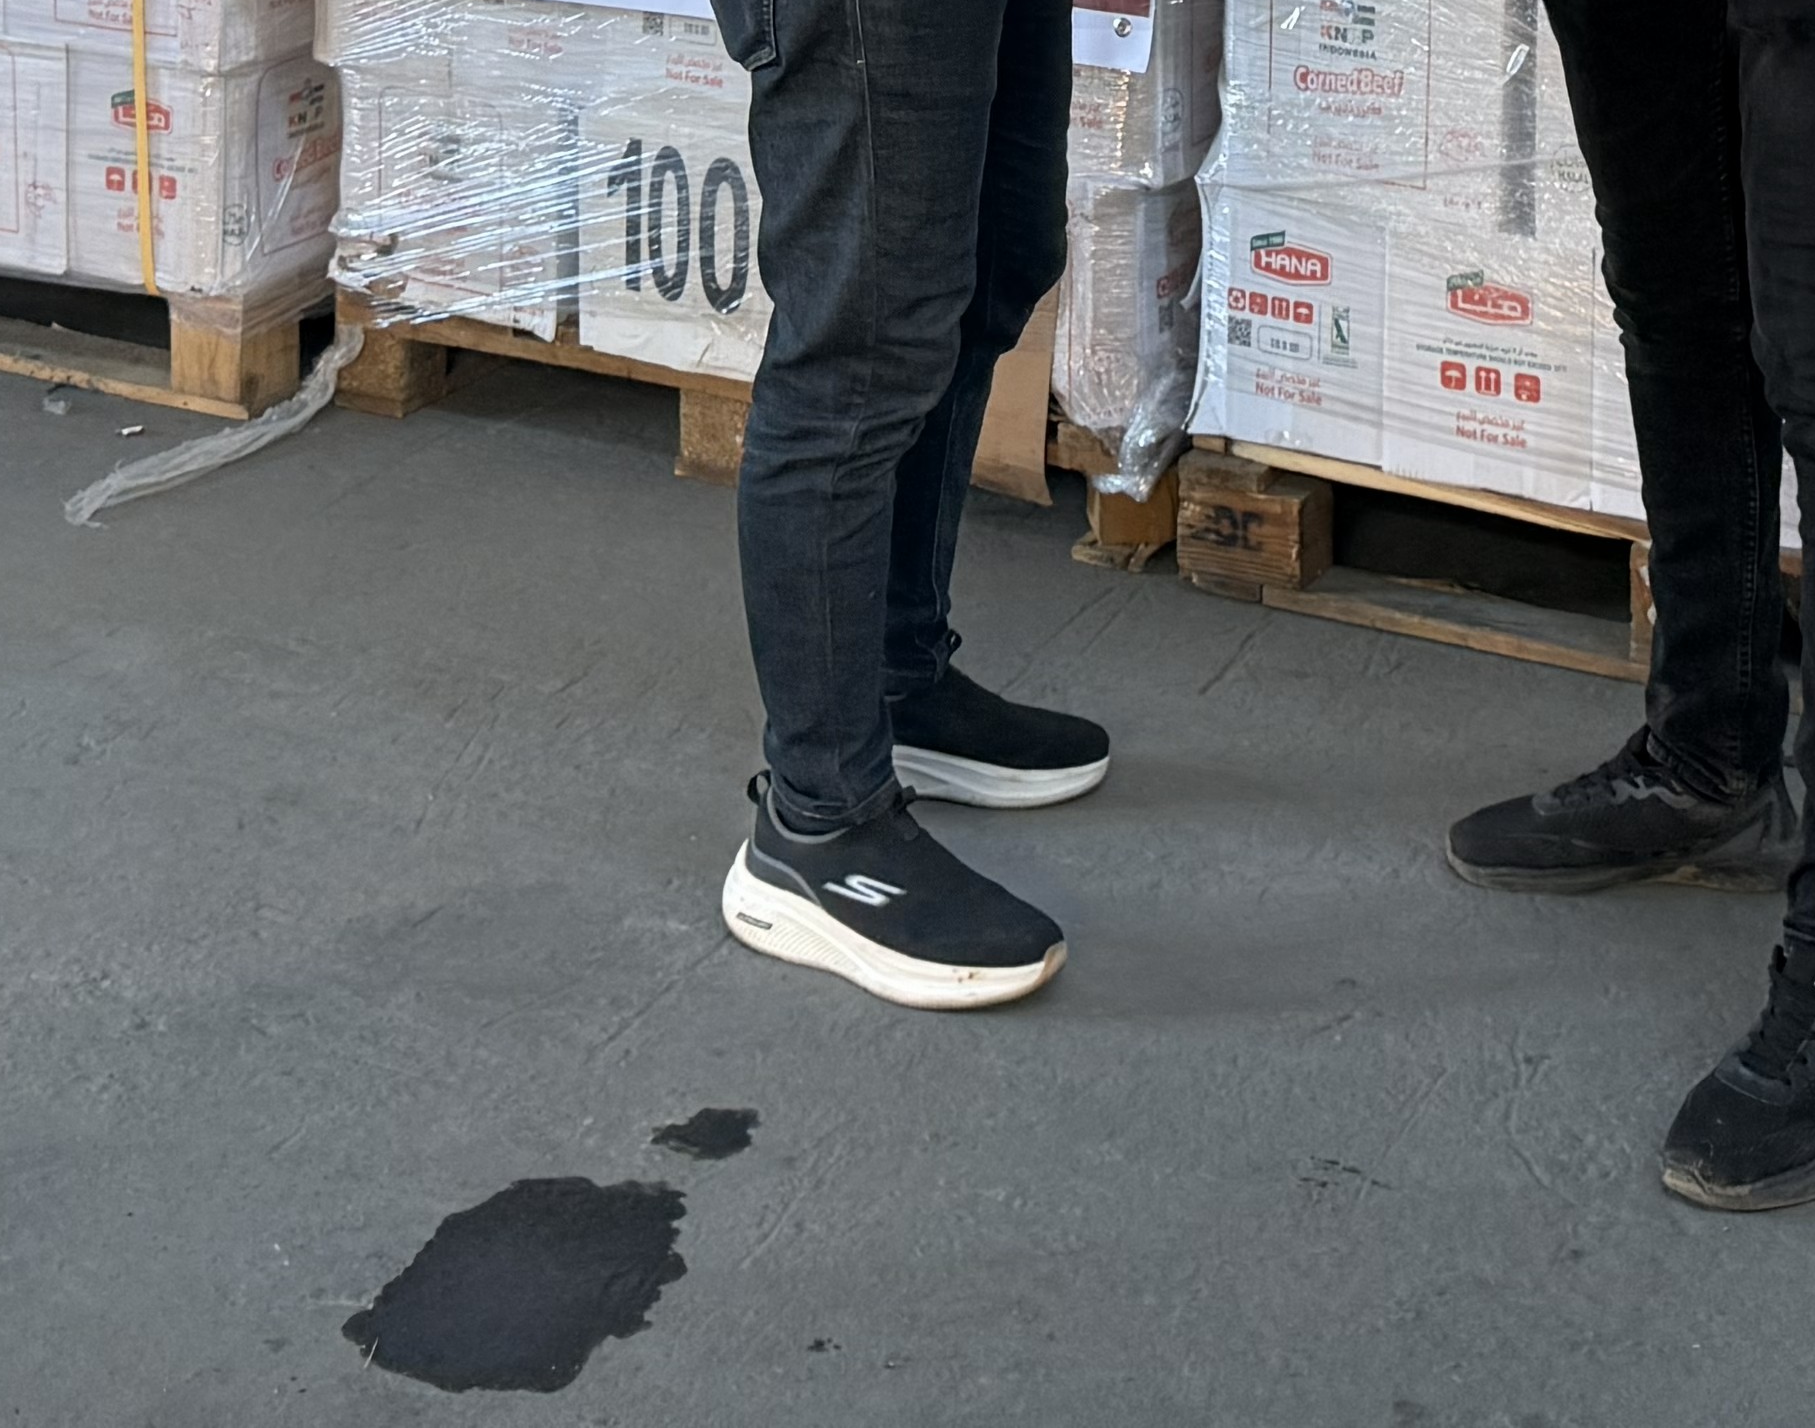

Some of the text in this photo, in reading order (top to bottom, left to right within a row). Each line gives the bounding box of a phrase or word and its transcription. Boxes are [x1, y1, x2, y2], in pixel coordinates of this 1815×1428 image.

[1319, 24, 1376, 45] KNP
[1293, 65, 1405, 96] Corned Beef
[608, 138, 750, 314] 100
[1260, 250, 1322, 278] HANA
[1255, 381, 1322, 406] Not For Sale
[1455, 424, 1528, 449] Not For Sale
